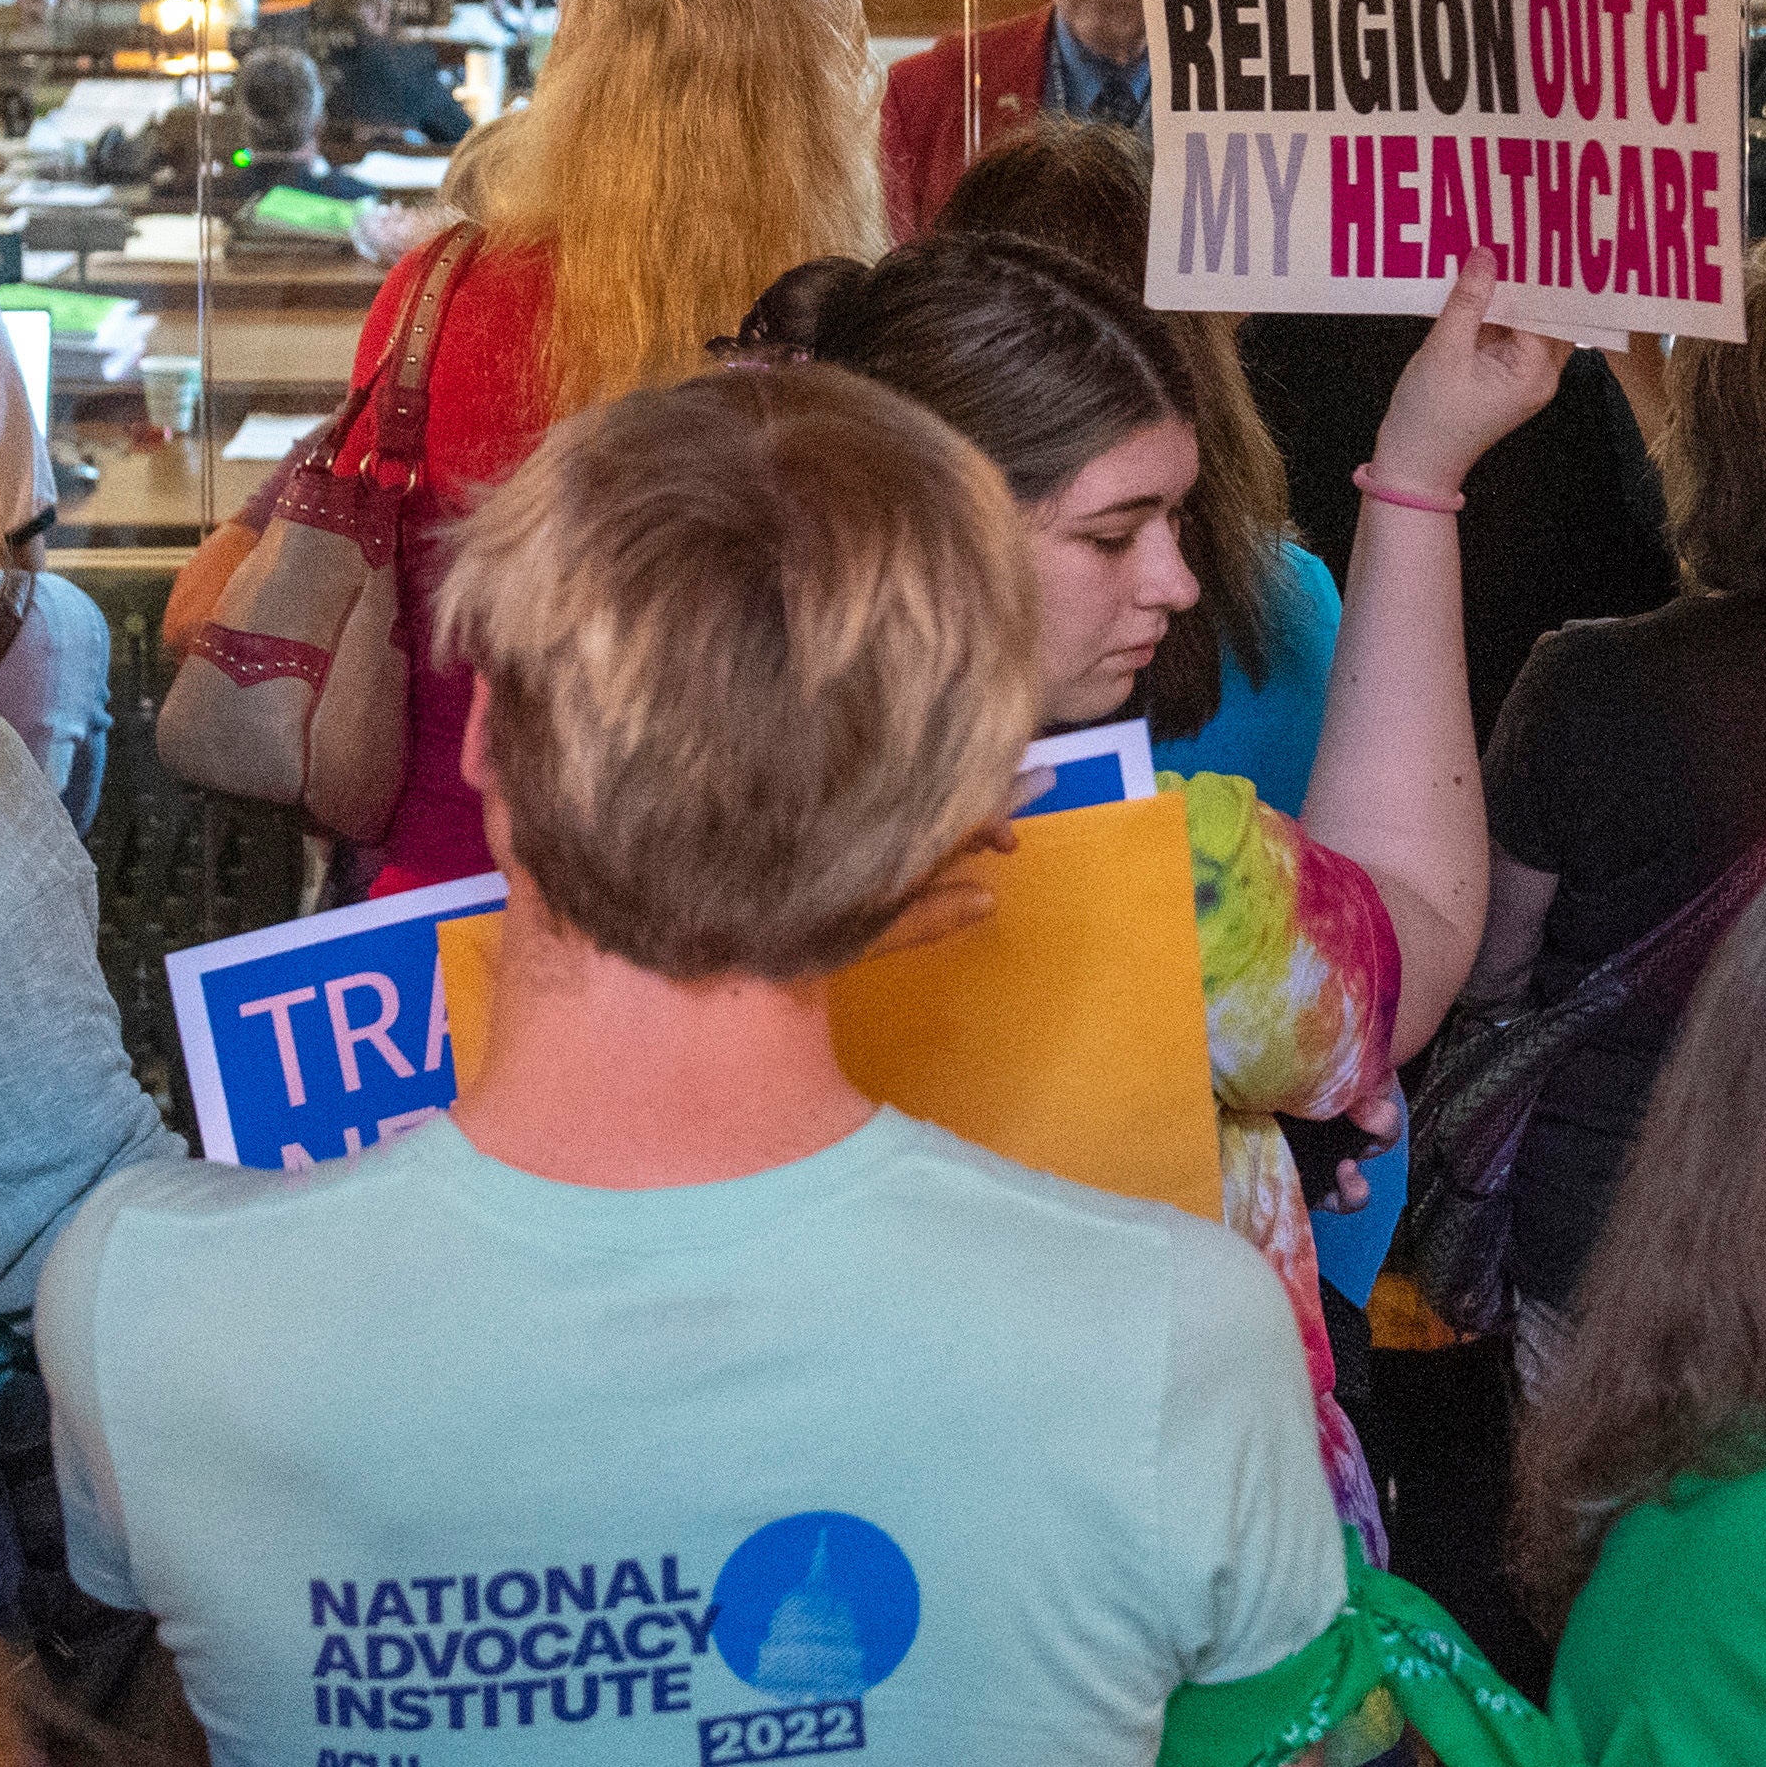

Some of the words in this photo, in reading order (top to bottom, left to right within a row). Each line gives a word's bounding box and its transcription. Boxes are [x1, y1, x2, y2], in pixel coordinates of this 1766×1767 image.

[1177, 132, 1308, 276] MY
[1330, 135, 1722, 304] HEALTHCARE
[310, 1554, 701, 1627] NATIONAL
[313, 1604, 722, 1681] ADVOCACY
[314, 1664, 691, 1732] INSTITUTE
[708, 1704, 856, 1763] 2022
